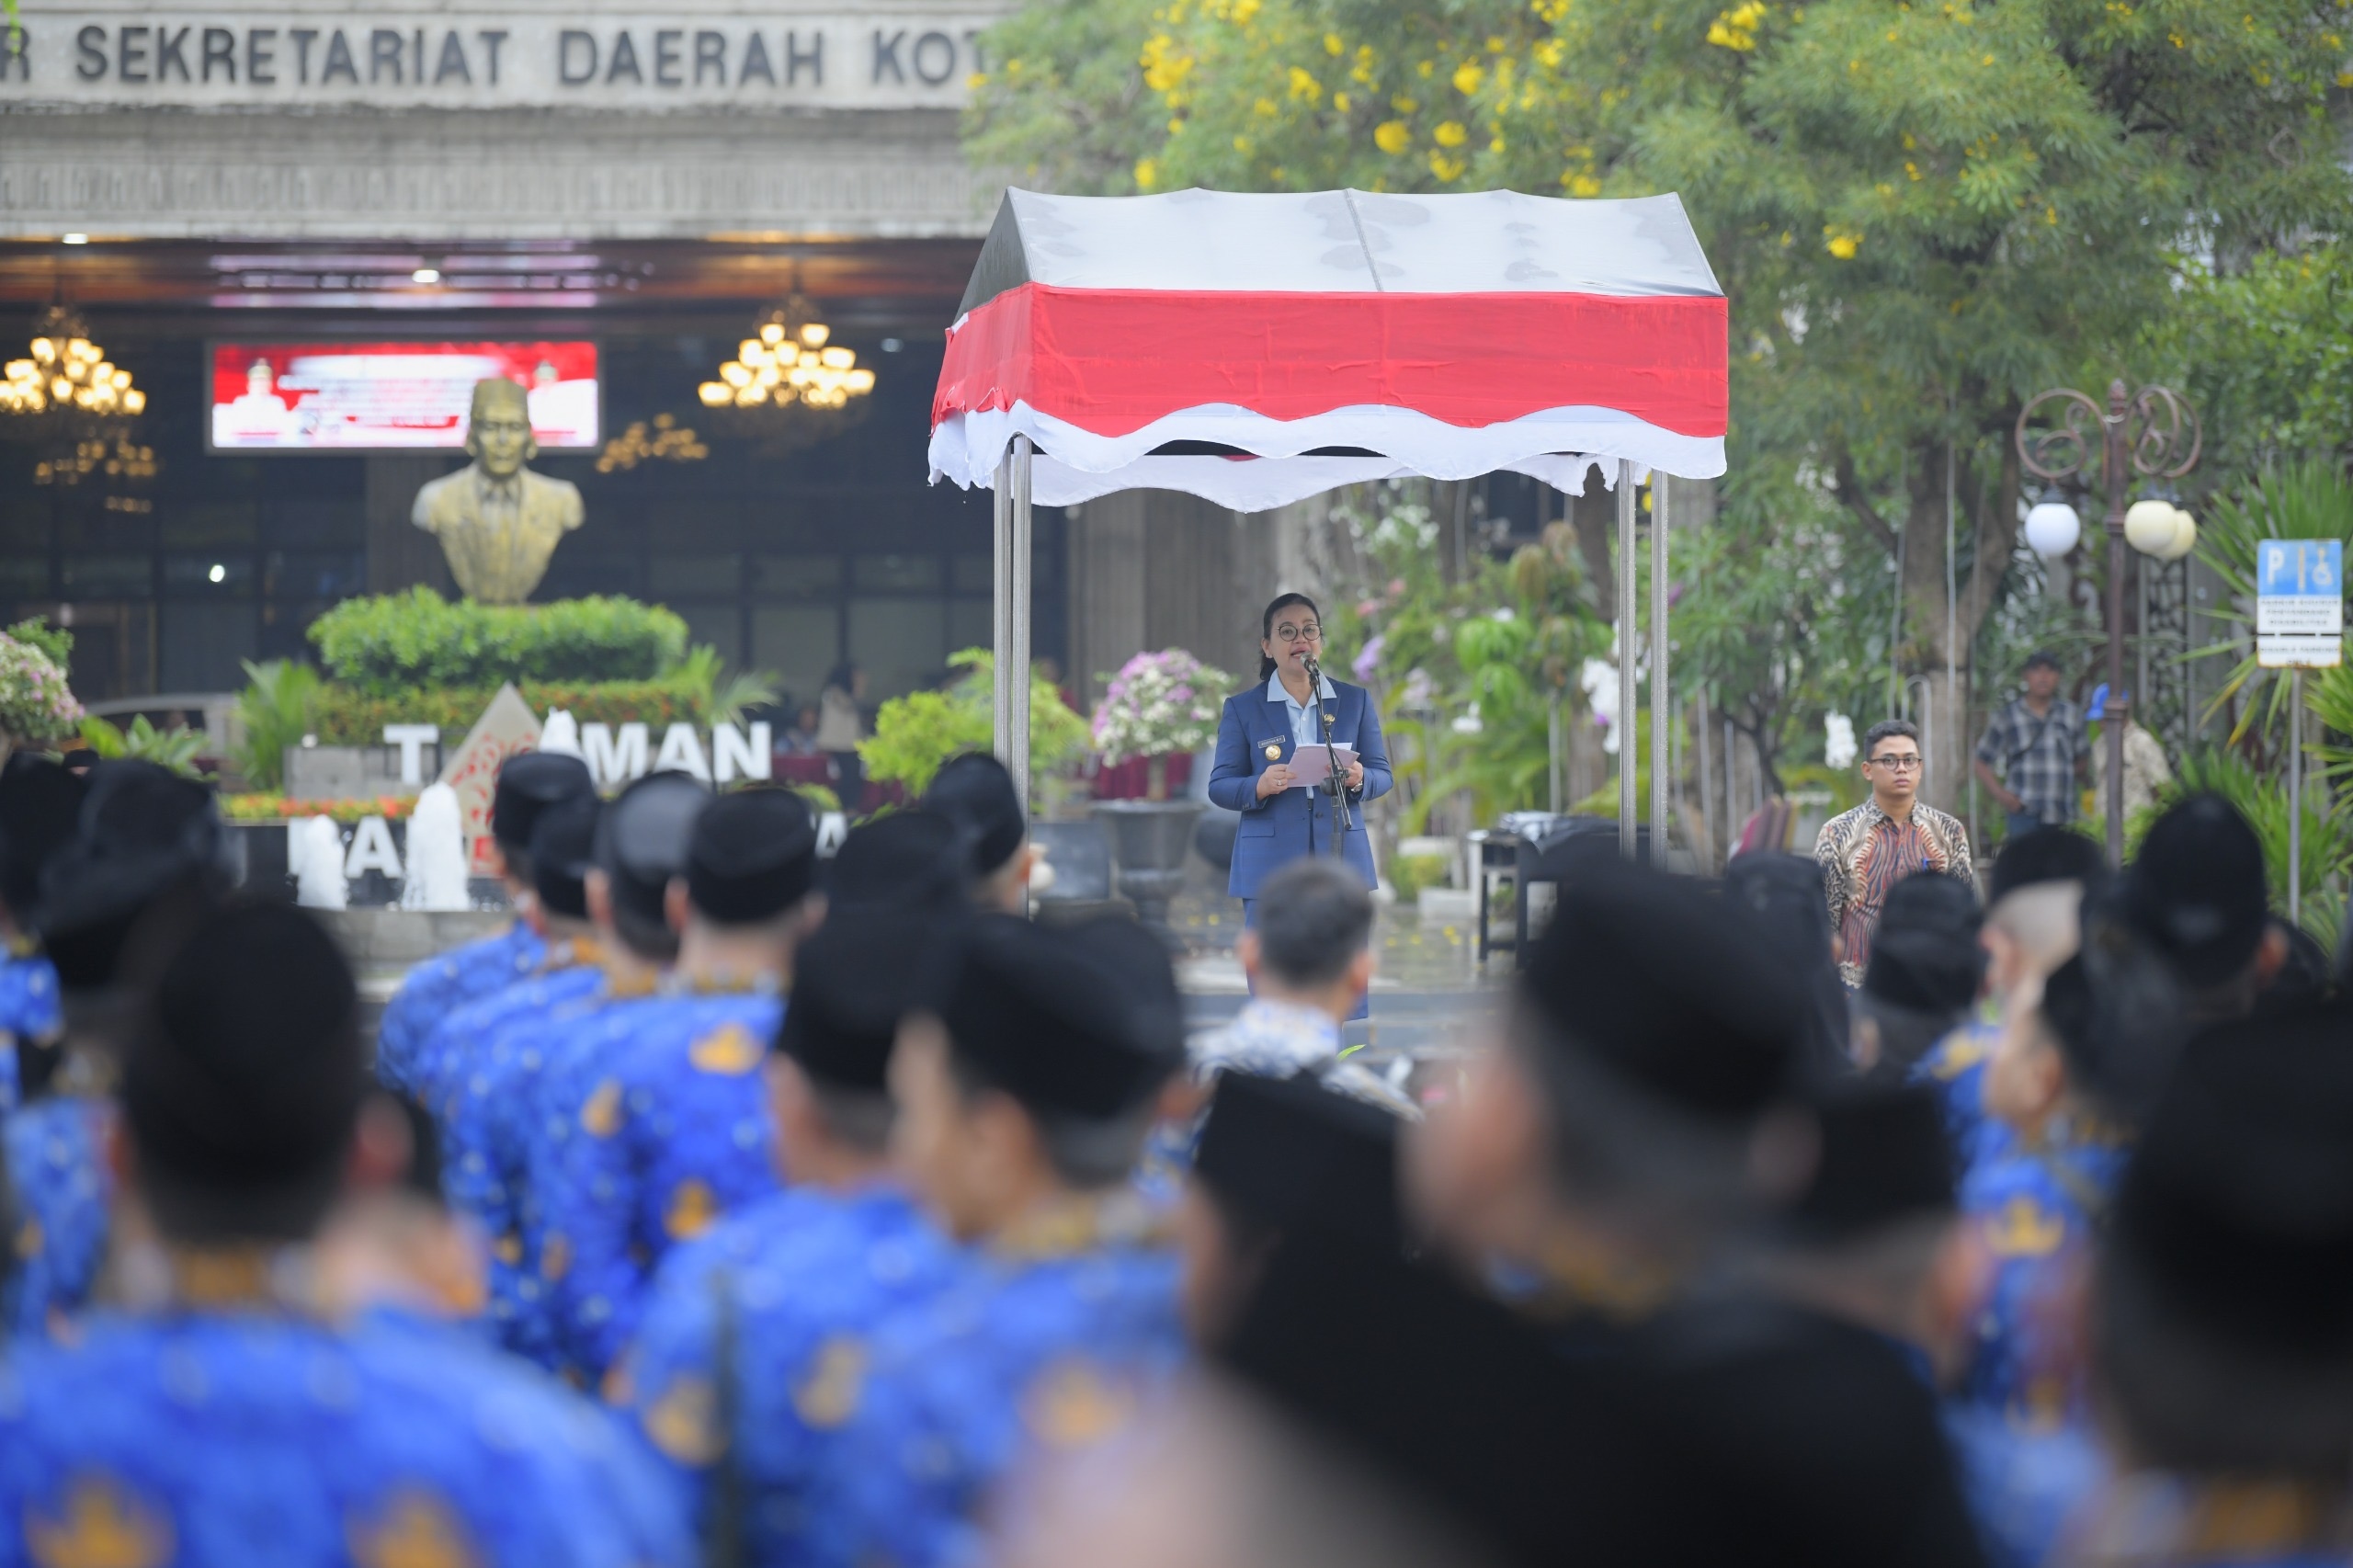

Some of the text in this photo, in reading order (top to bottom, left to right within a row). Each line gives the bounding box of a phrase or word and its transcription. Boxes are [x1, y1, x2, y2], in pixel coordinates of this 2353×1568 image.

[76, 26, 508, 85] SEKRETARIAT
[559, 30, 823, 85] DAERAH
[2268, 549, 2284, 585] P
